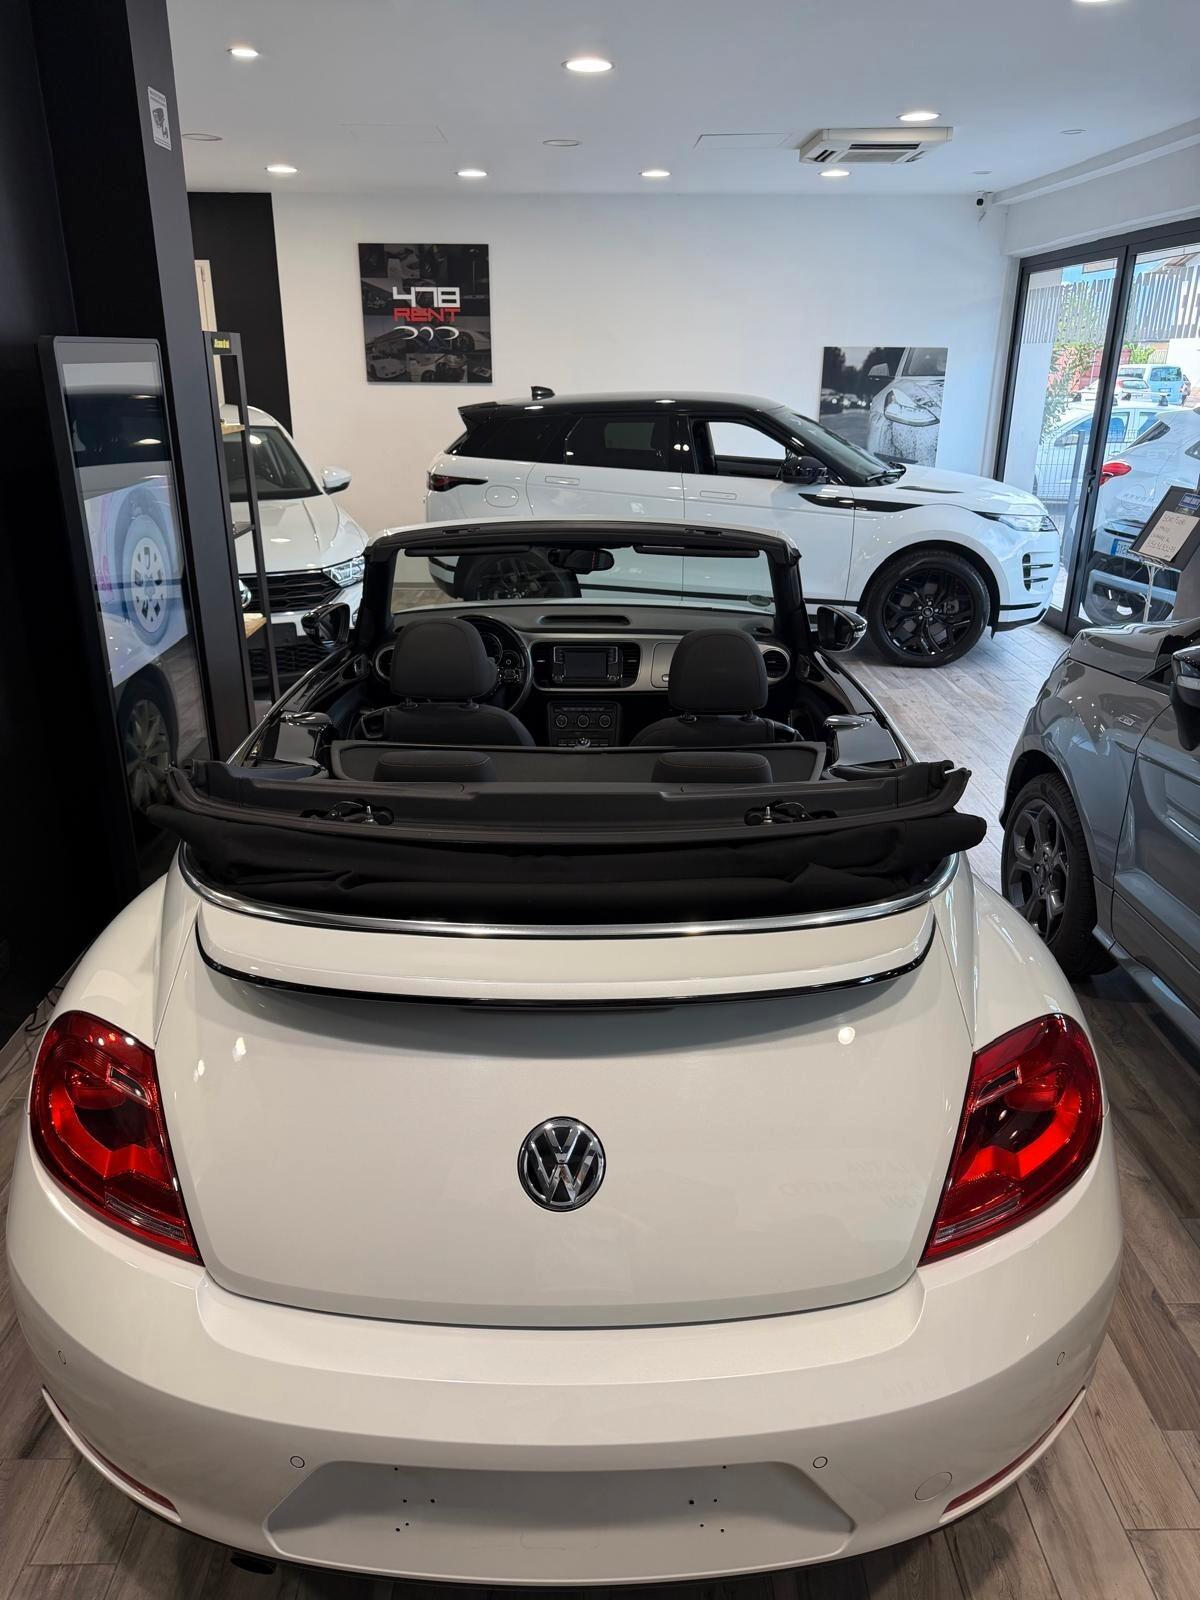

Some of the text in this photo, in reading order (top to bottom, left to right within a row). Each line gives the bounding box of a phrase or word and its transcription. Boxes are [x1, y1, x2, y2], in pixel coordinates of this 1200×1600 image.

[392, 286, 461, 308] 478
[392, 307, 461, 322] RENT
[525, 1122, 599, 1206] VW
